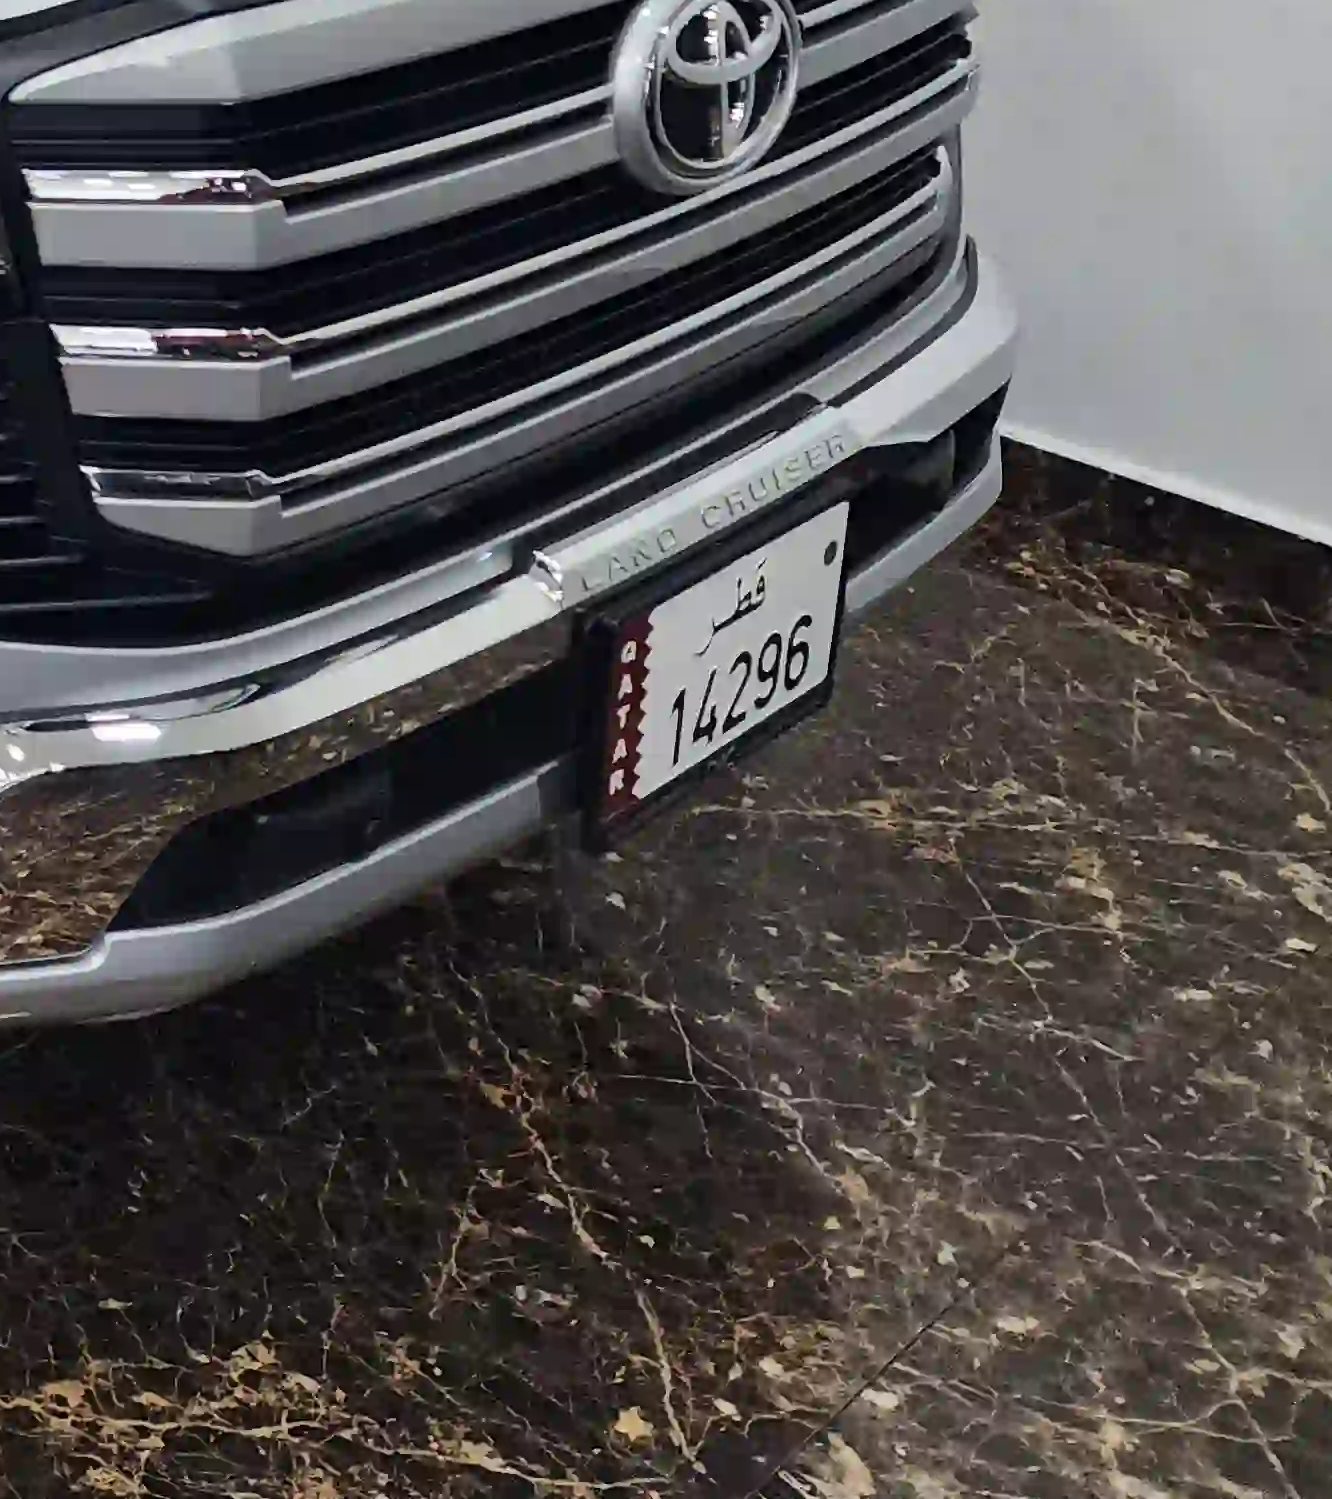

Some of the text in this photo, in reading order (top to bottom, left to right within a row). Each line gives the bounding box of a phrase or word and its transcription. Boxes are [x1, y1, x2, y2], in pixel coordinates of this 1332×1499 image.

[581, 434, 848, 591] LAND CRUISER
[694, 557, 768, 656] قطر
[671, 614, 813, 768] 14296
